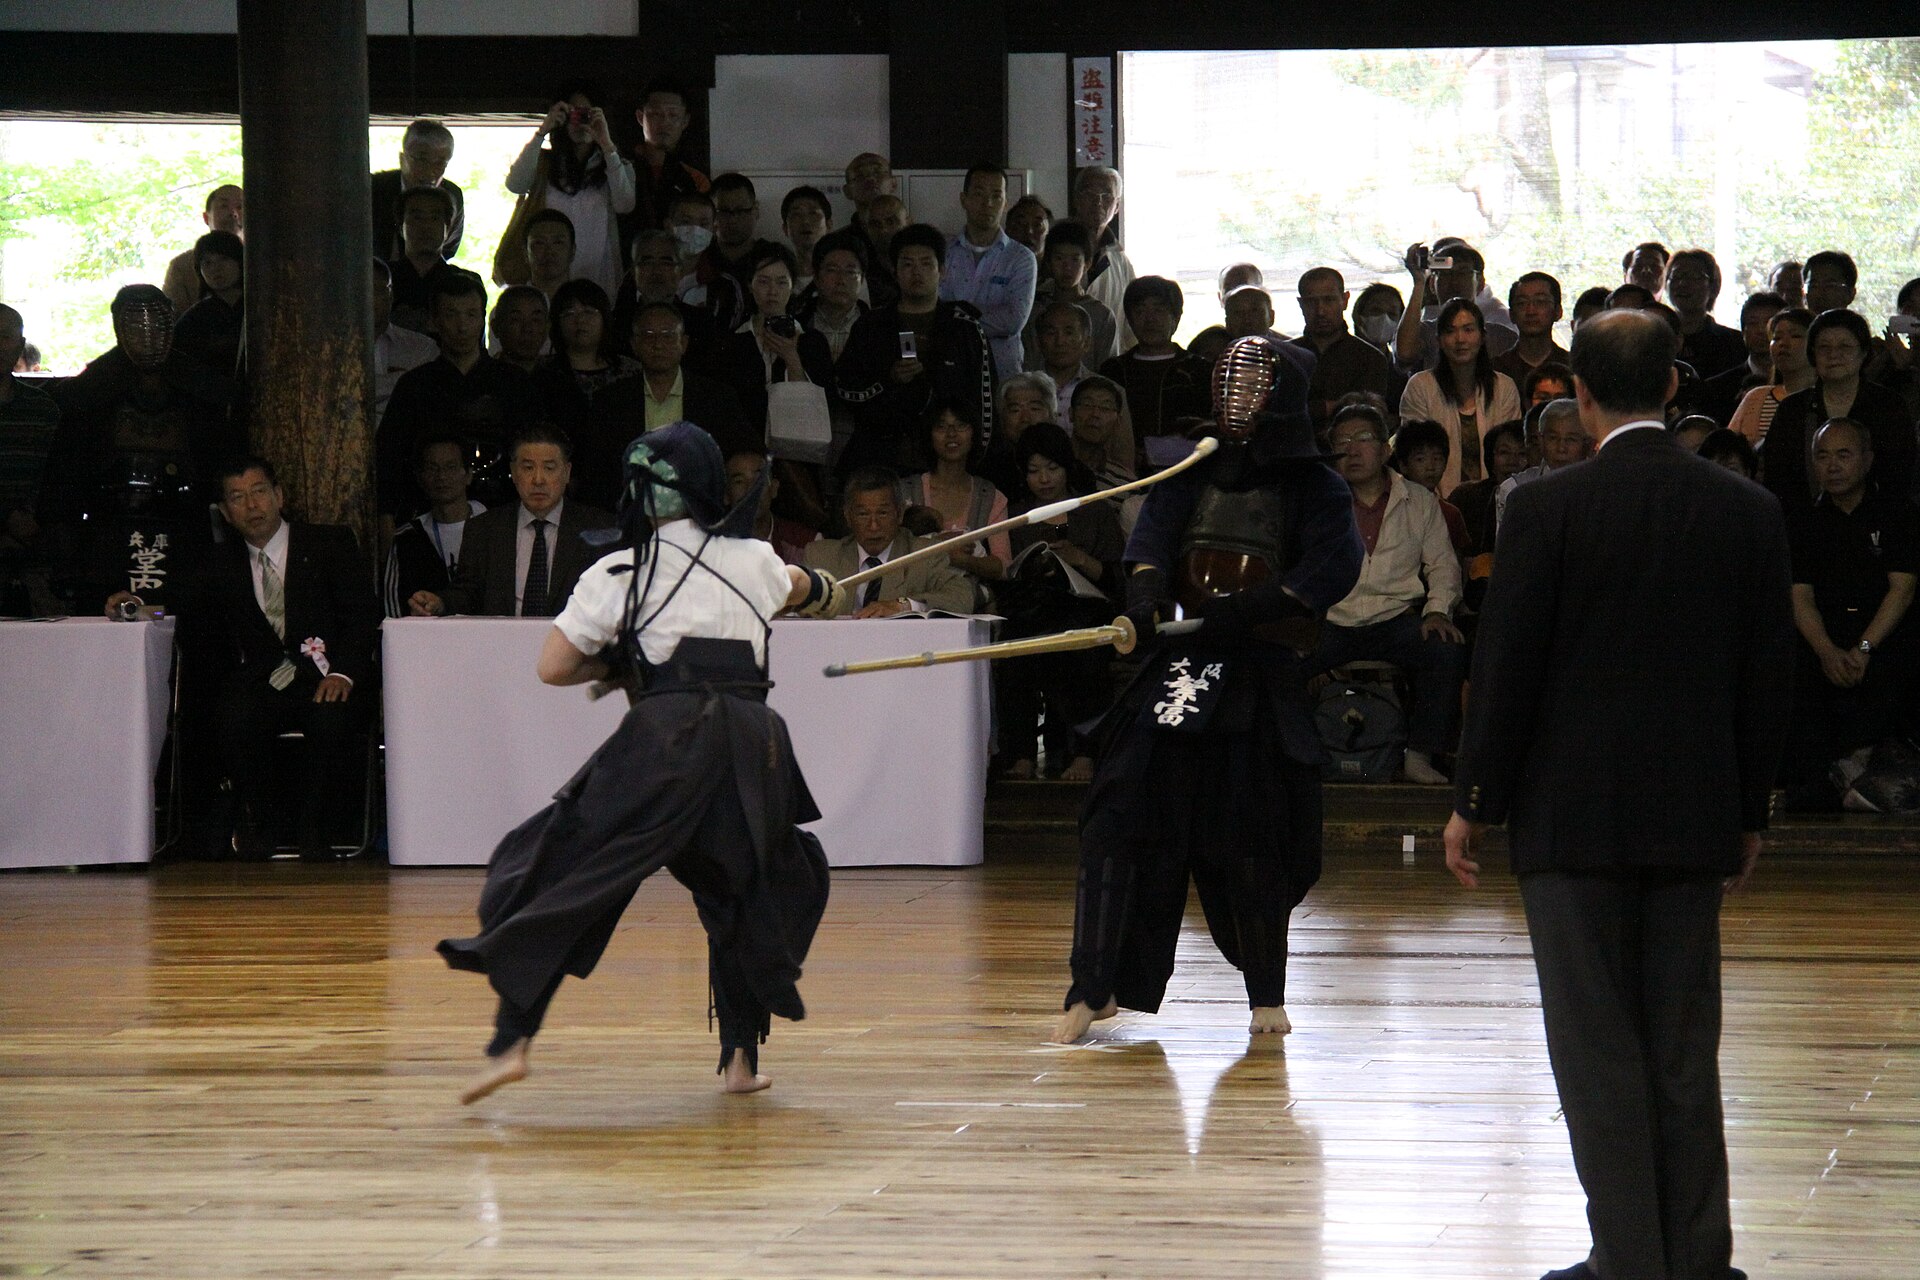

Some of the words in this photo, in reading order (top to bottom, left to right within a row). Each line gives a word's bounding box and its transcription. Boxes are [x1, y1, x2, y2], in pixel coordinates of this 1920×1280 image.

[1081, 68, 1105, 160] 盗難注意
[128, 530, 169, 550] 兵庫
[127, 547, 167, 593] 堂内
[1168, 656, 1224, 681] 大阪
